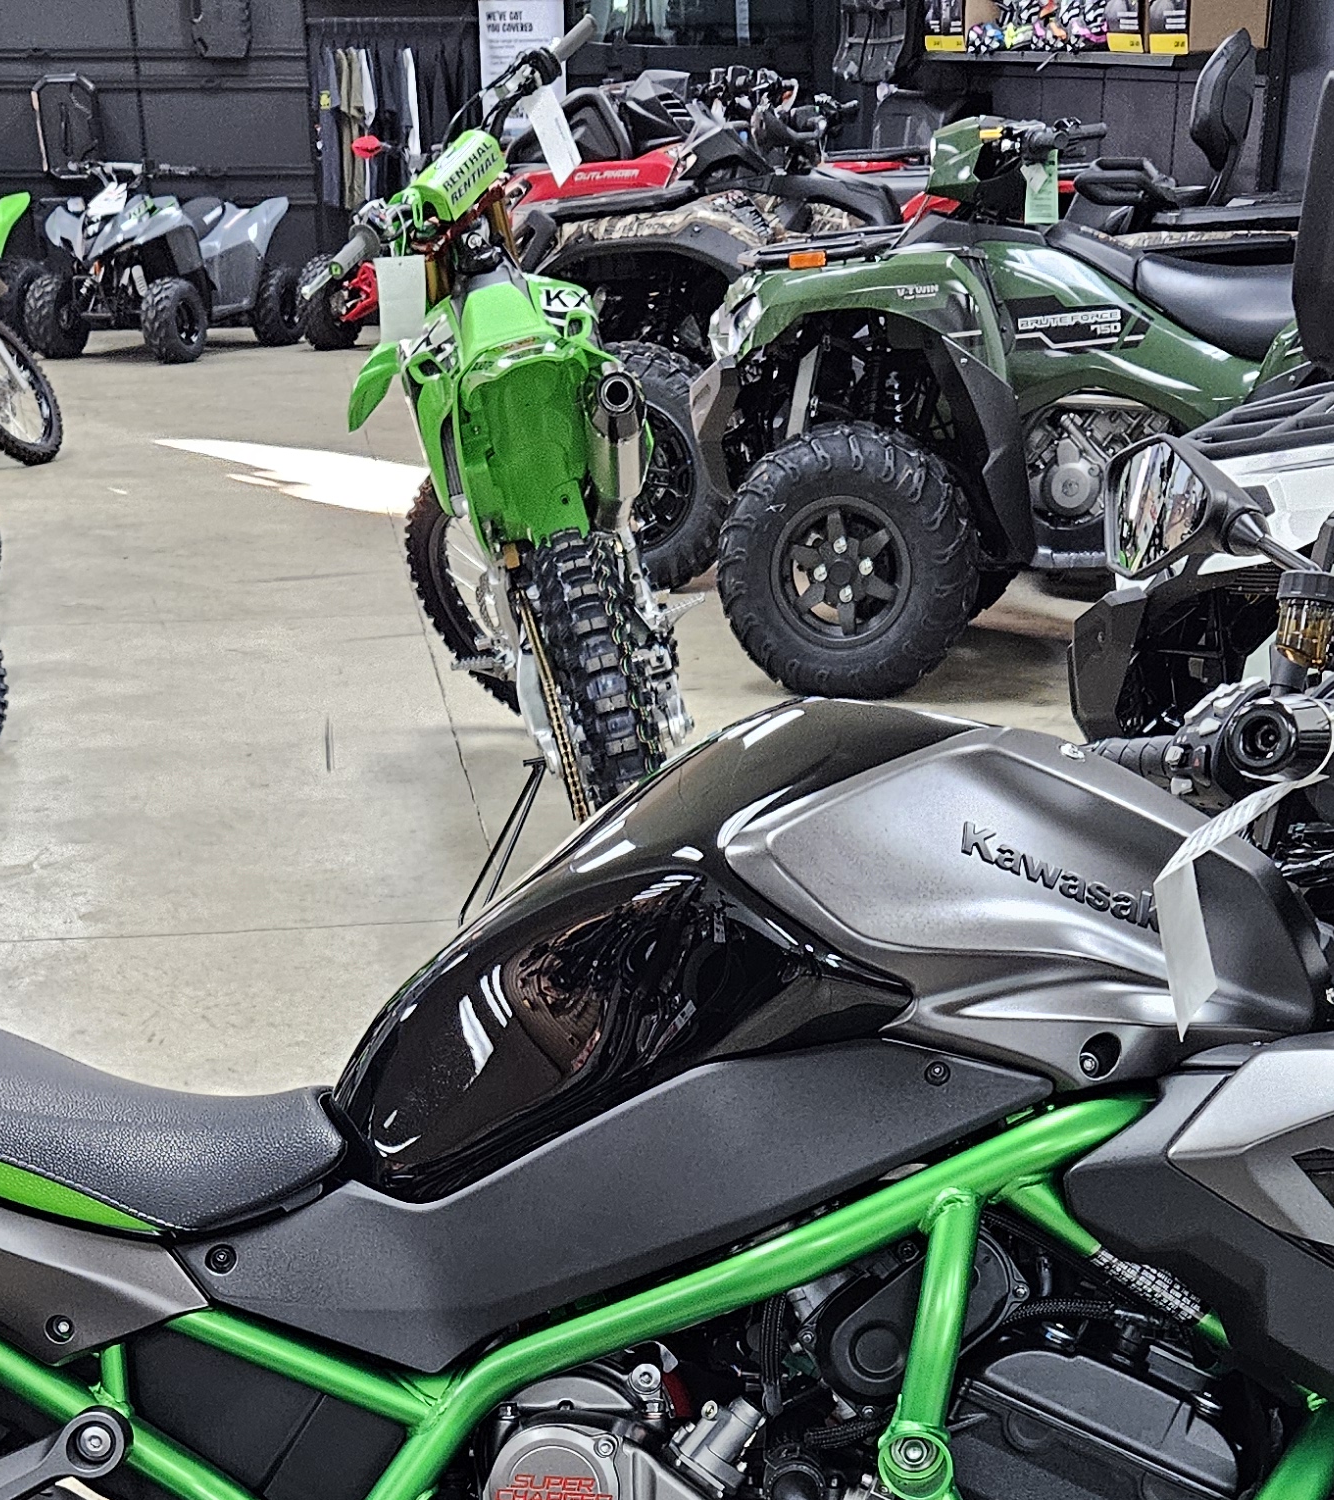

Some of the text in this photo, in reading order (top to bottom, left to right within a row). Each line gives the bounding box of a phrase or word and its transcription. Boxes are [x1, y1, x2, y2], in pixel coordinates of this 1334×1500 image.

[509, 11, 523, 21] GOT
[486, 22, 533, 33] YOU COVERED
[442, 141, 493, 192] RENTHAL
[450, 152, 499, 205] RENTHAL
[574, 168, 641, 182] OUTLANDER
[896, 284, 939, 297] V-TWIN
[1090, 322, 1122, 335] 750
[960, 820, 1161, 934] Kawasak
[509, 1474, 596, 1492] SUPER
